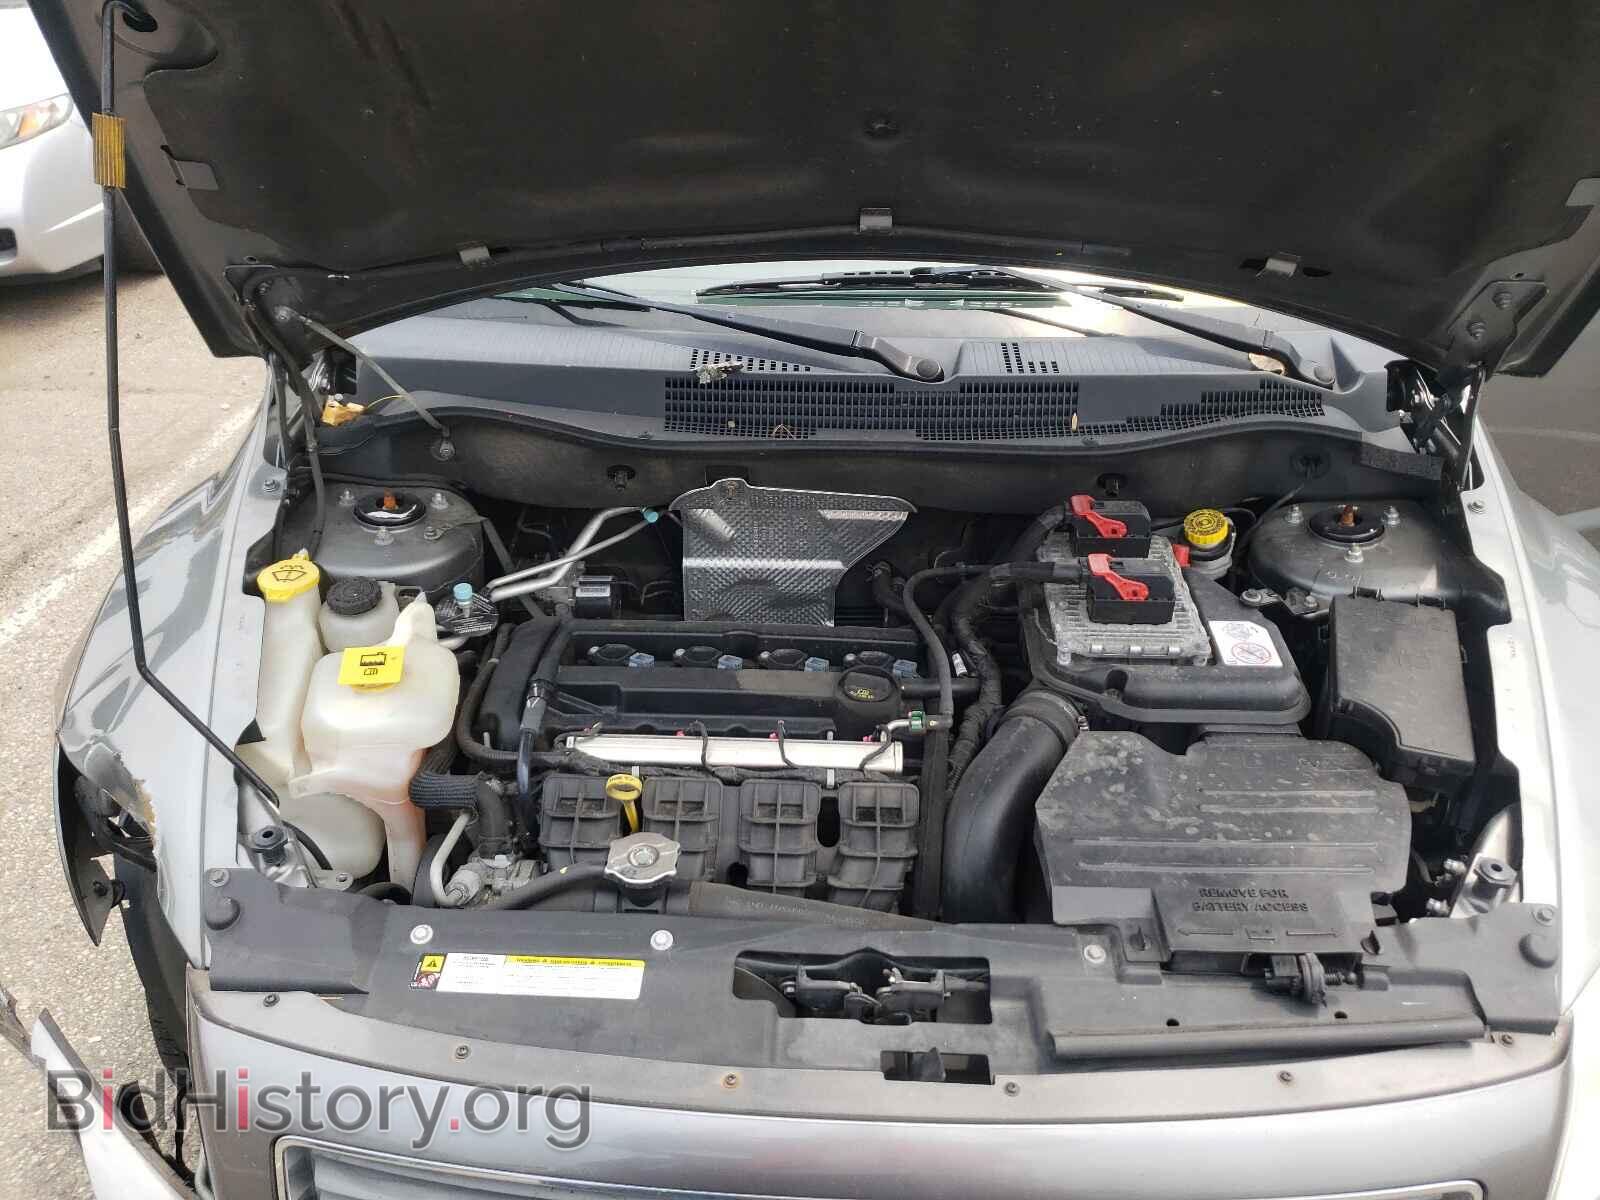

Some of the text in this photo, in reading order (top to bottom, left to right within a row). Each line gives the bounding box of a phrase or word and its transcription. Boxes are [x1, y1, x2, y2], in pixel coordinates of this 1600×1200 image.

[1199, 888, 1289, 898] REMOVE FOR
[1192, 902, 1309, 912] BATTERY ACCESS
